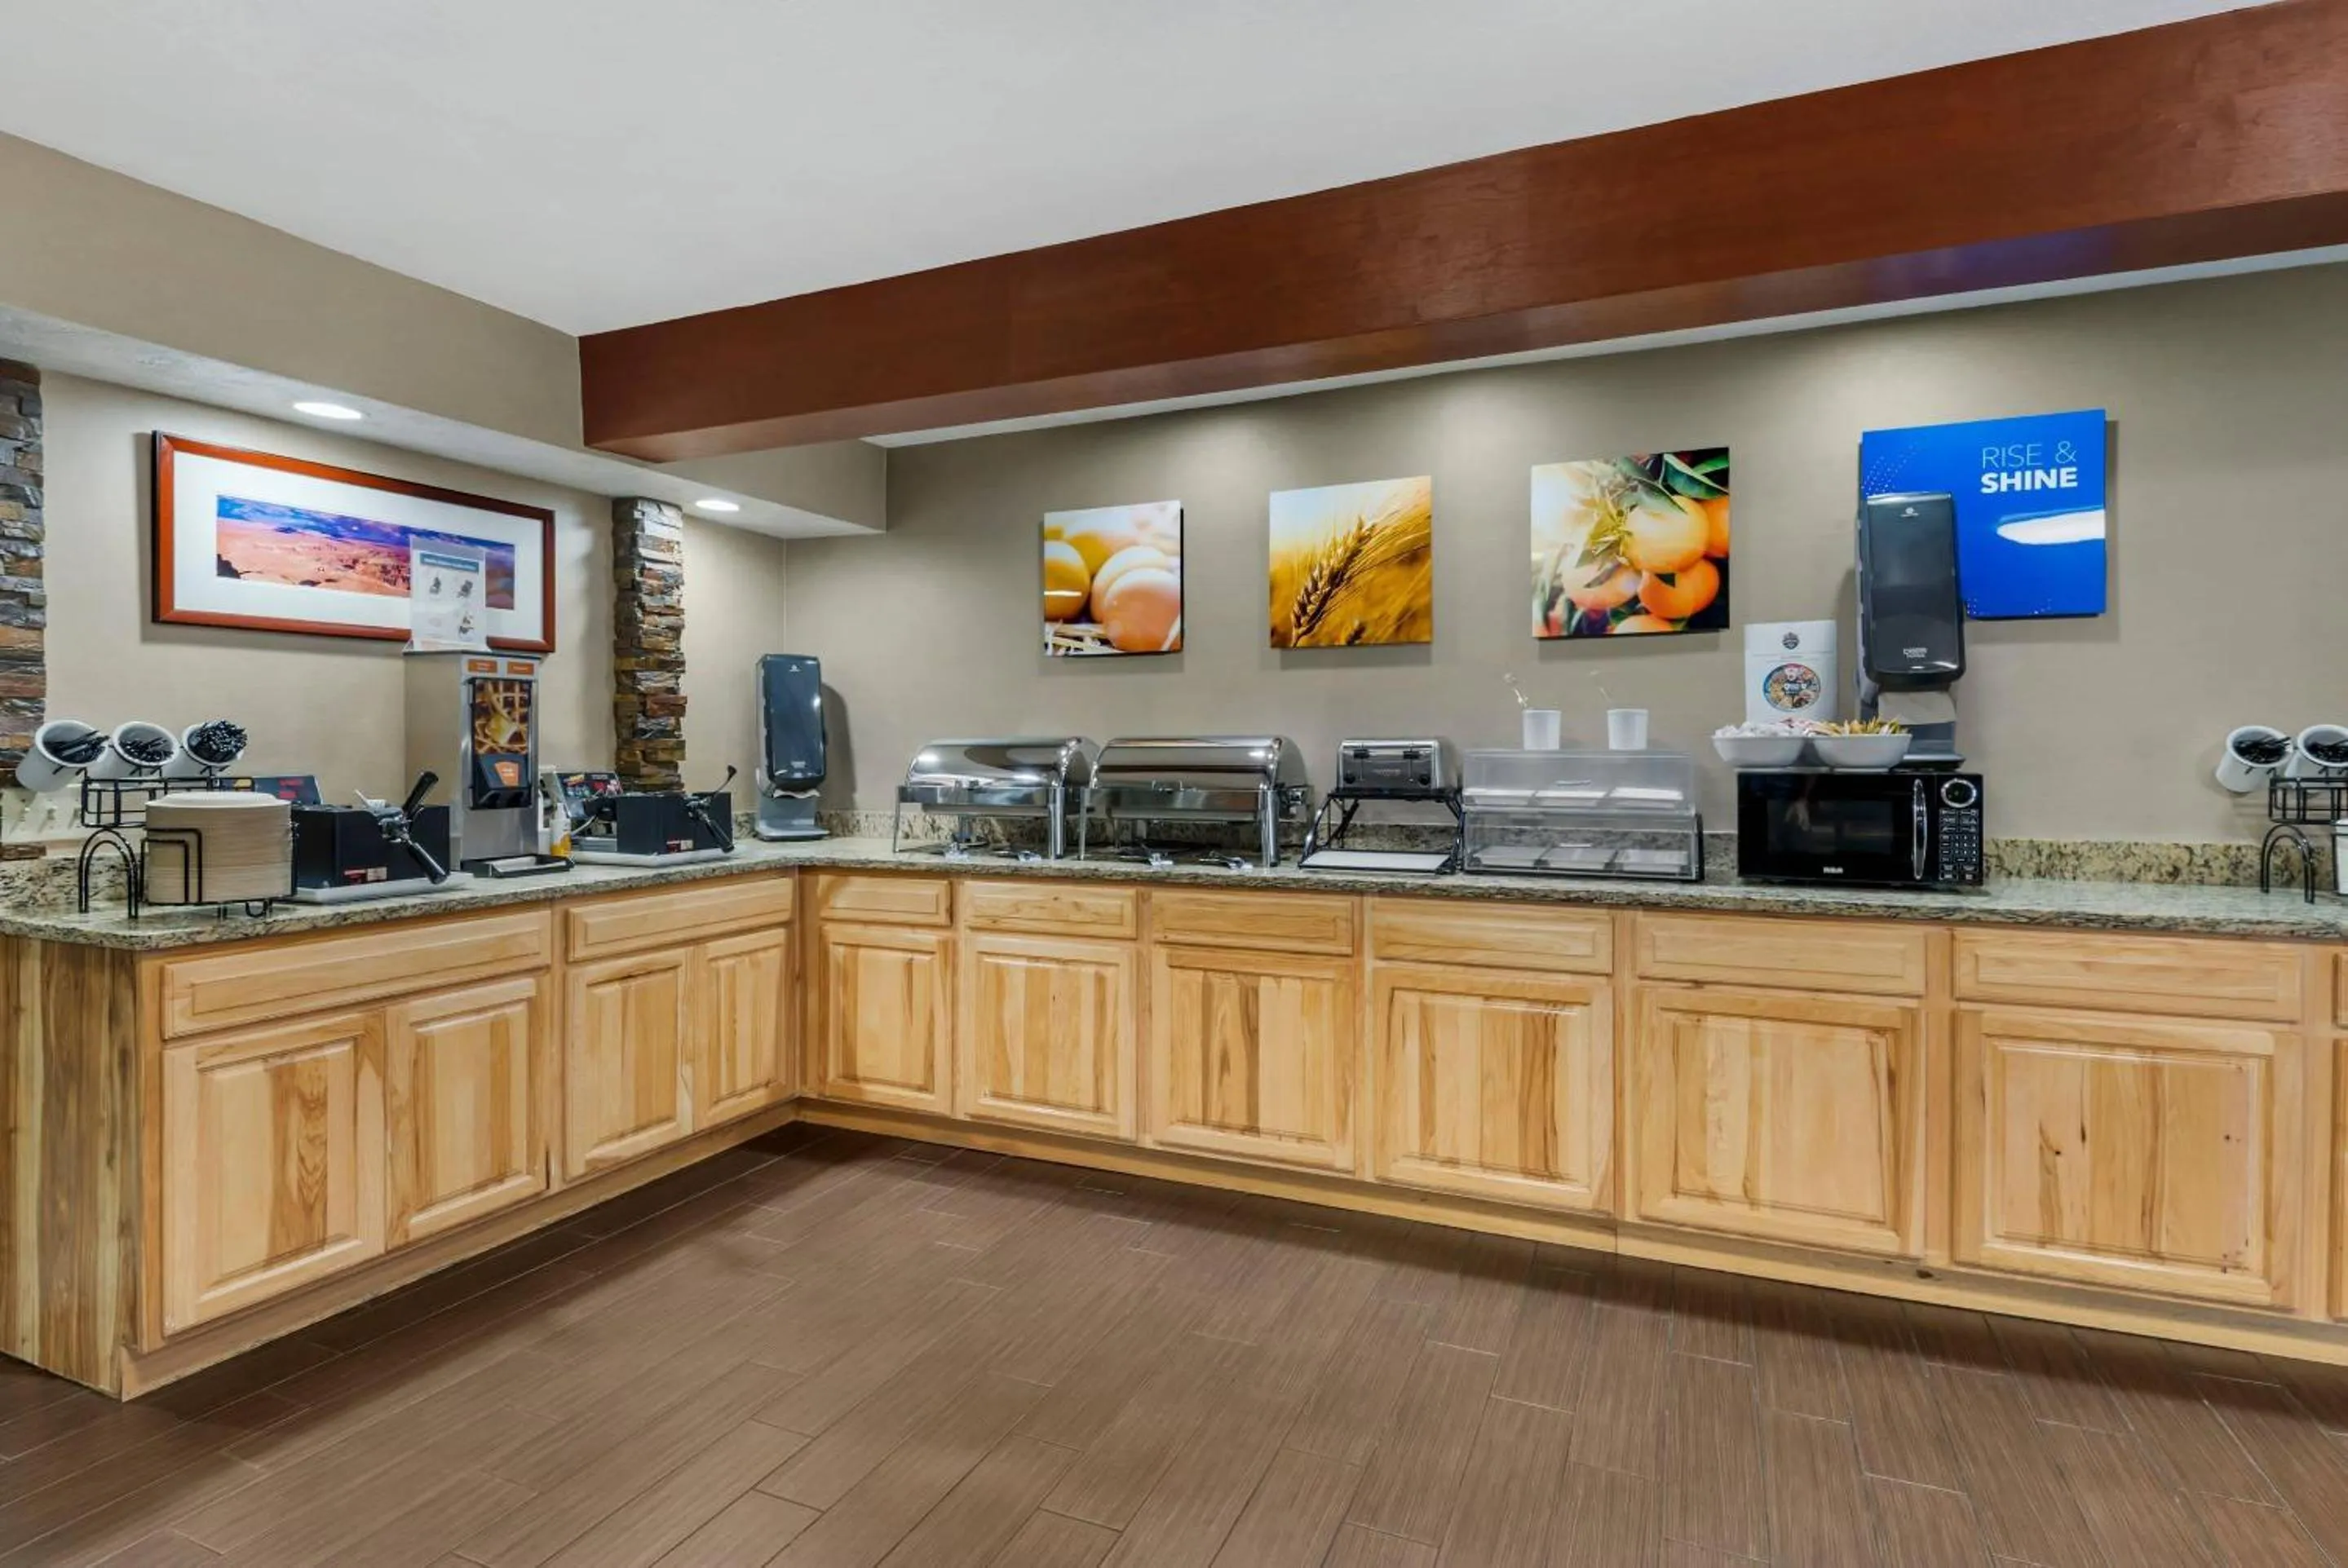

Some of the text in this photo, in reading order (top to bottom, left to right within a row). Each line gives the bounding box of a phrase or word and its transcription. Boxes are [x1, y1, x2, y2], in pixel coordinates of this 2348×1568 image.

[1982, 440, 2077, 469] RISE &
[1980, 466, 2079, 494] SHINE
